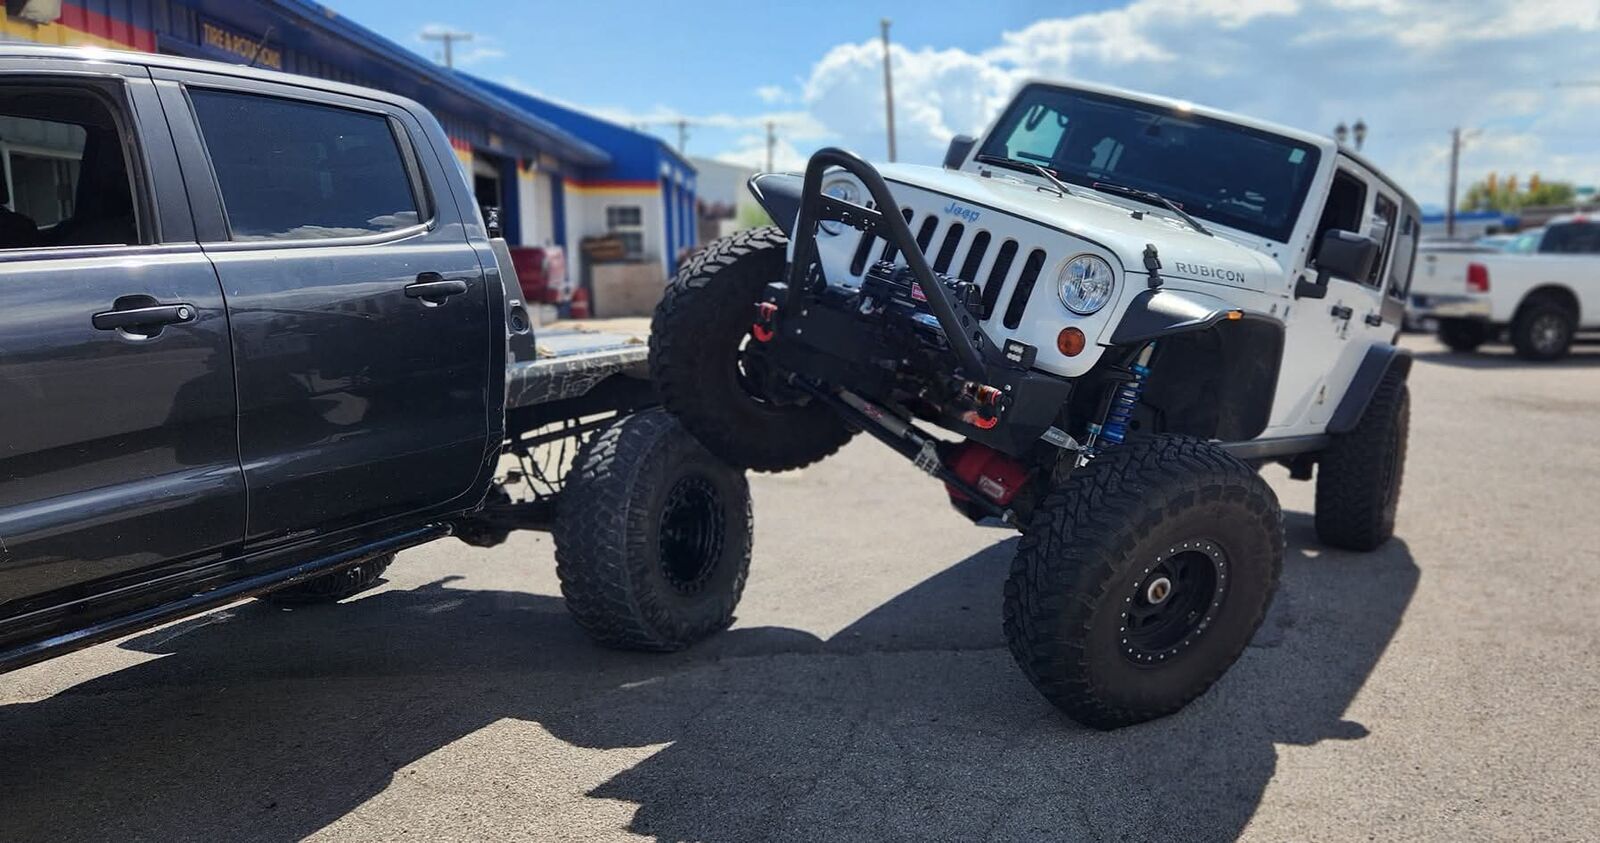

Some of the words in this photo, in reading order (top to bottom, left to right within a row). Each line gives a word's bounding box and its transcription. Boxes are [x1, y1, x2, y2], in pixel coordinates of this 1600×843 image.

[203, 23, 224, 50] TIRE
[944, 202, 980, 223] Jeep
[1175, 262, 1245, 283] RUBICON
